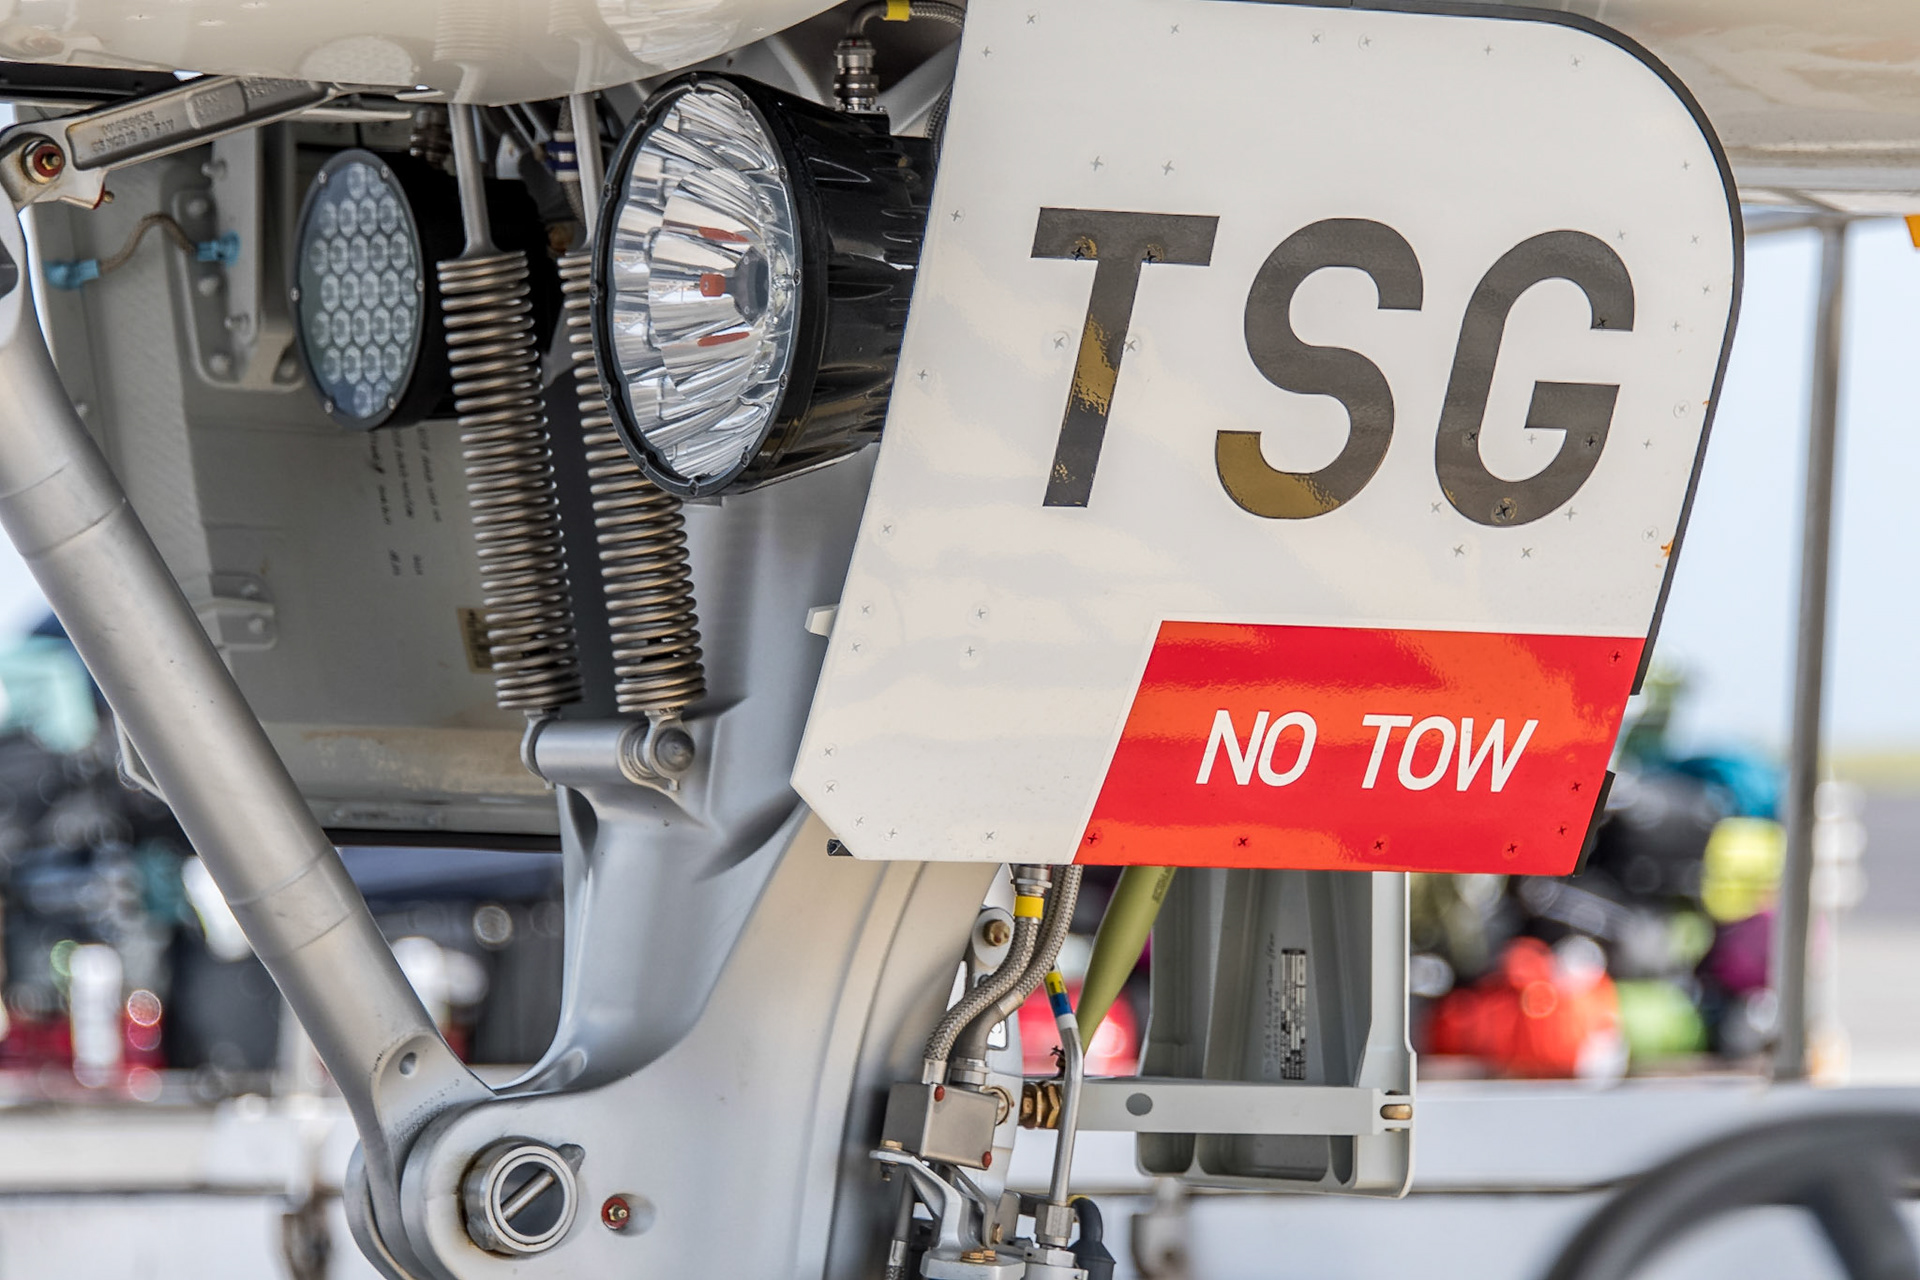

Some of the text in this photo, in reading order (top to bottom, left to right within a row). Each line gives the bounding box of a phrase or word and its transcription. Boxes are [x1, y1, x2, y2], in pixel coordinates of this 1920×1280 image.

[1031, 207, 1634, 527] TSG
[1196, 710, 1539, 793] NO TOW
